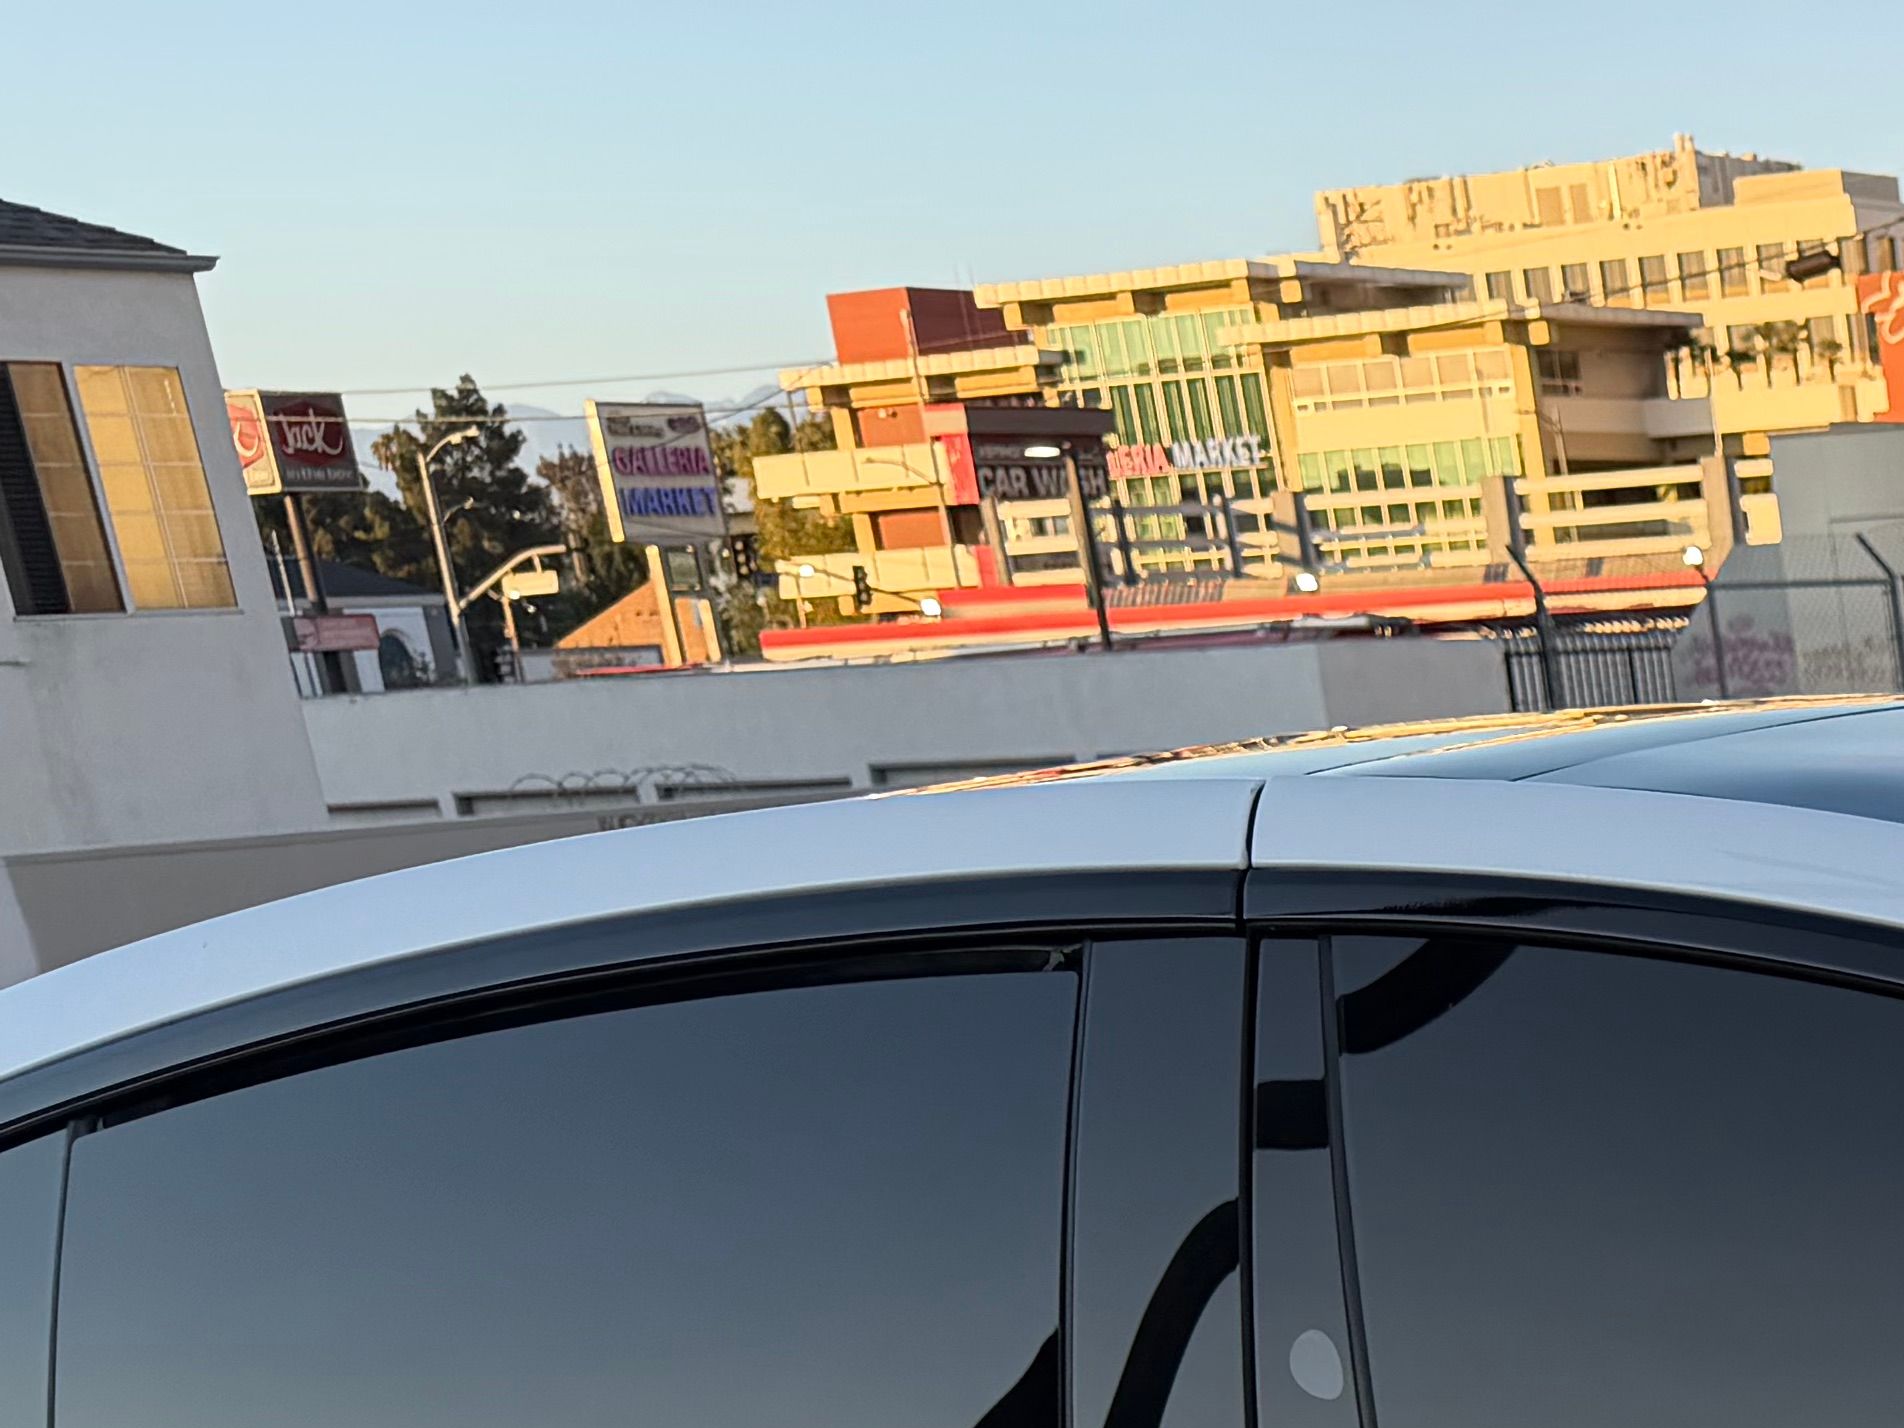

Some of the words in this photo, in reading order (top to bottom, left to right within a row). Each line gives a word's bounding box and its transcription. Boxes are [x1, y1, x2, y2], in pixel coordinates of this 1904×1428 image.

[282, 408, 343, 455] Jack
[612, 445, 709, 476] GALLERIA
[978, 466, 1030, 498] CAR
[620, 486, 718, 517] MARKET
